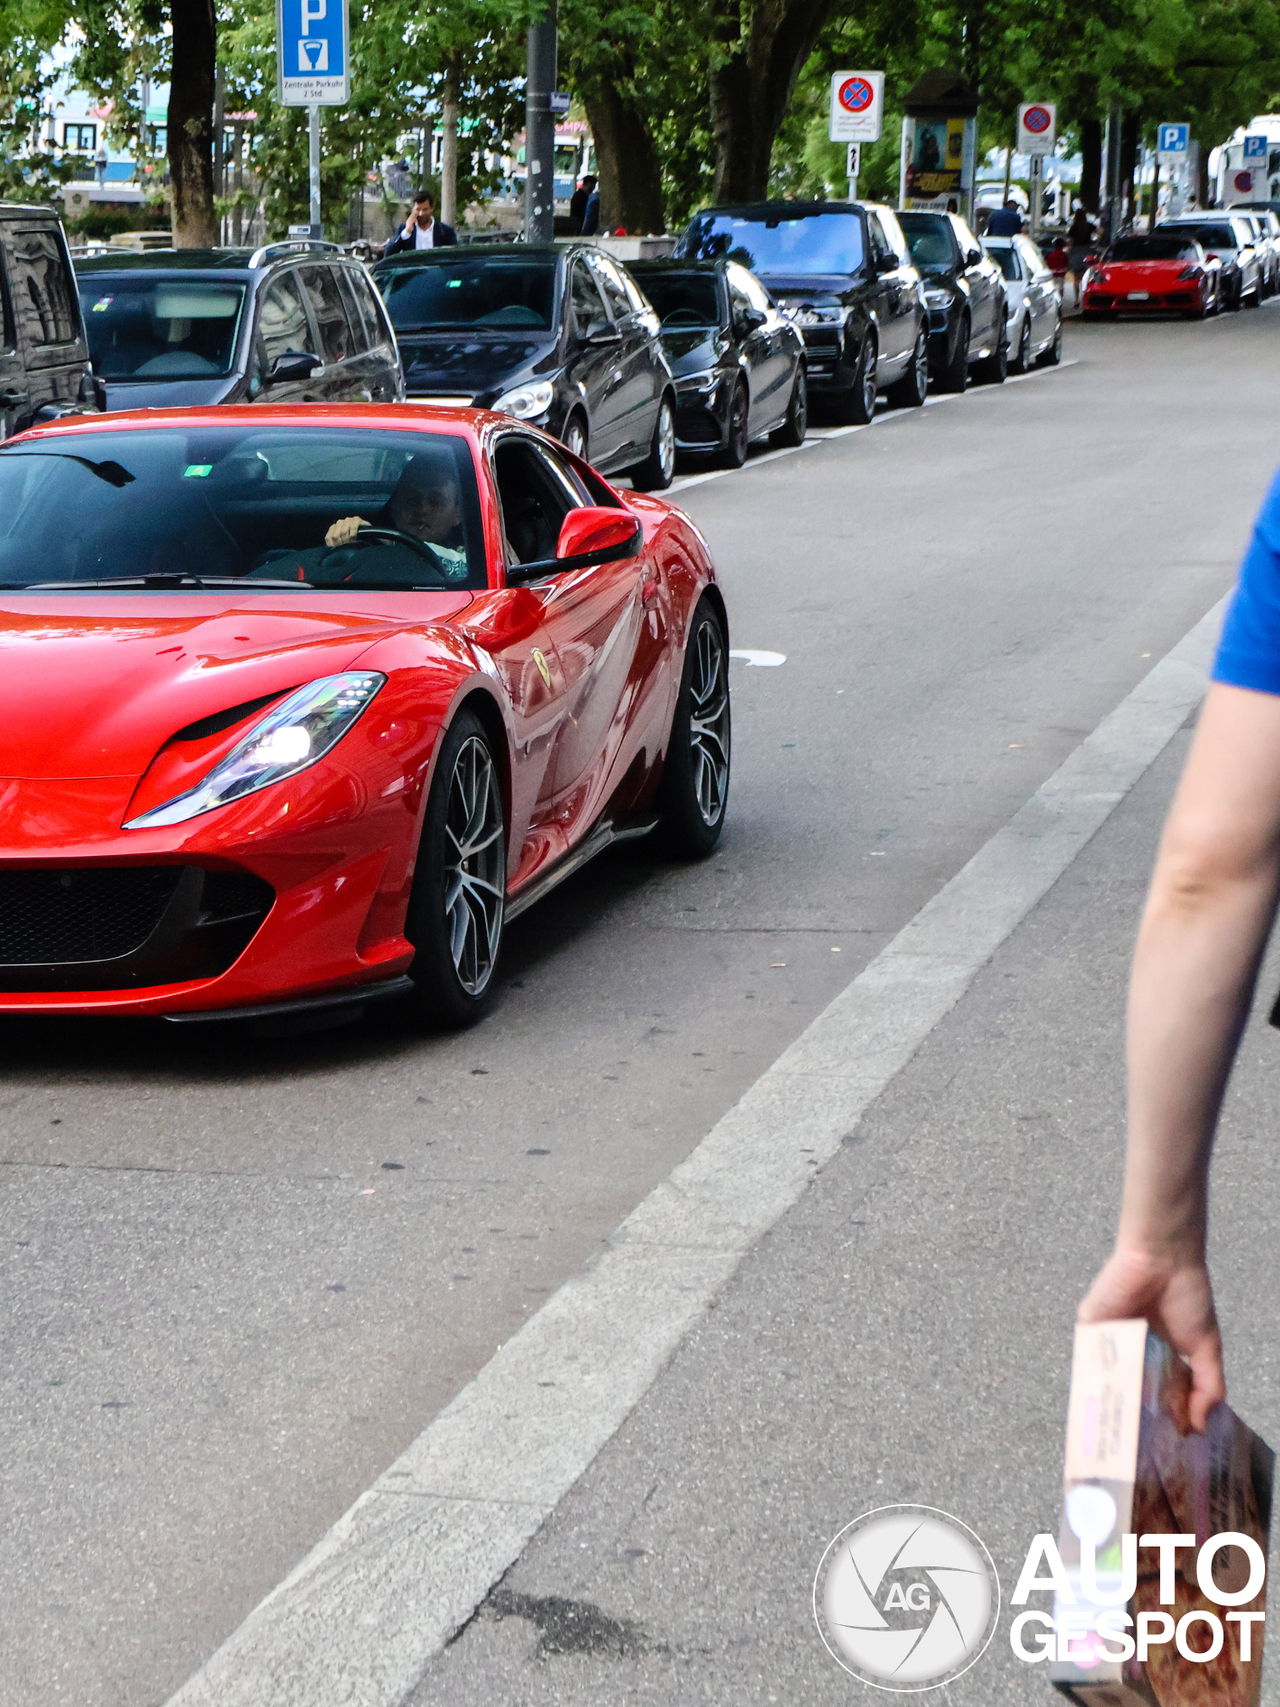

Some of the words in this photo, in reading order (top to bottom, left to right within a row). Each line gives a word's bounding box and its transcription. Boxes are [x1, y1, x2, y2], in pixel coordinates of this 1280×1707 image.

[301, 0, 327, 36] P
[284, 81, 314, 89] Zentrale
[316, 80, 344, 88] Parkuhr
[1165, 128, 1180, 149] P
